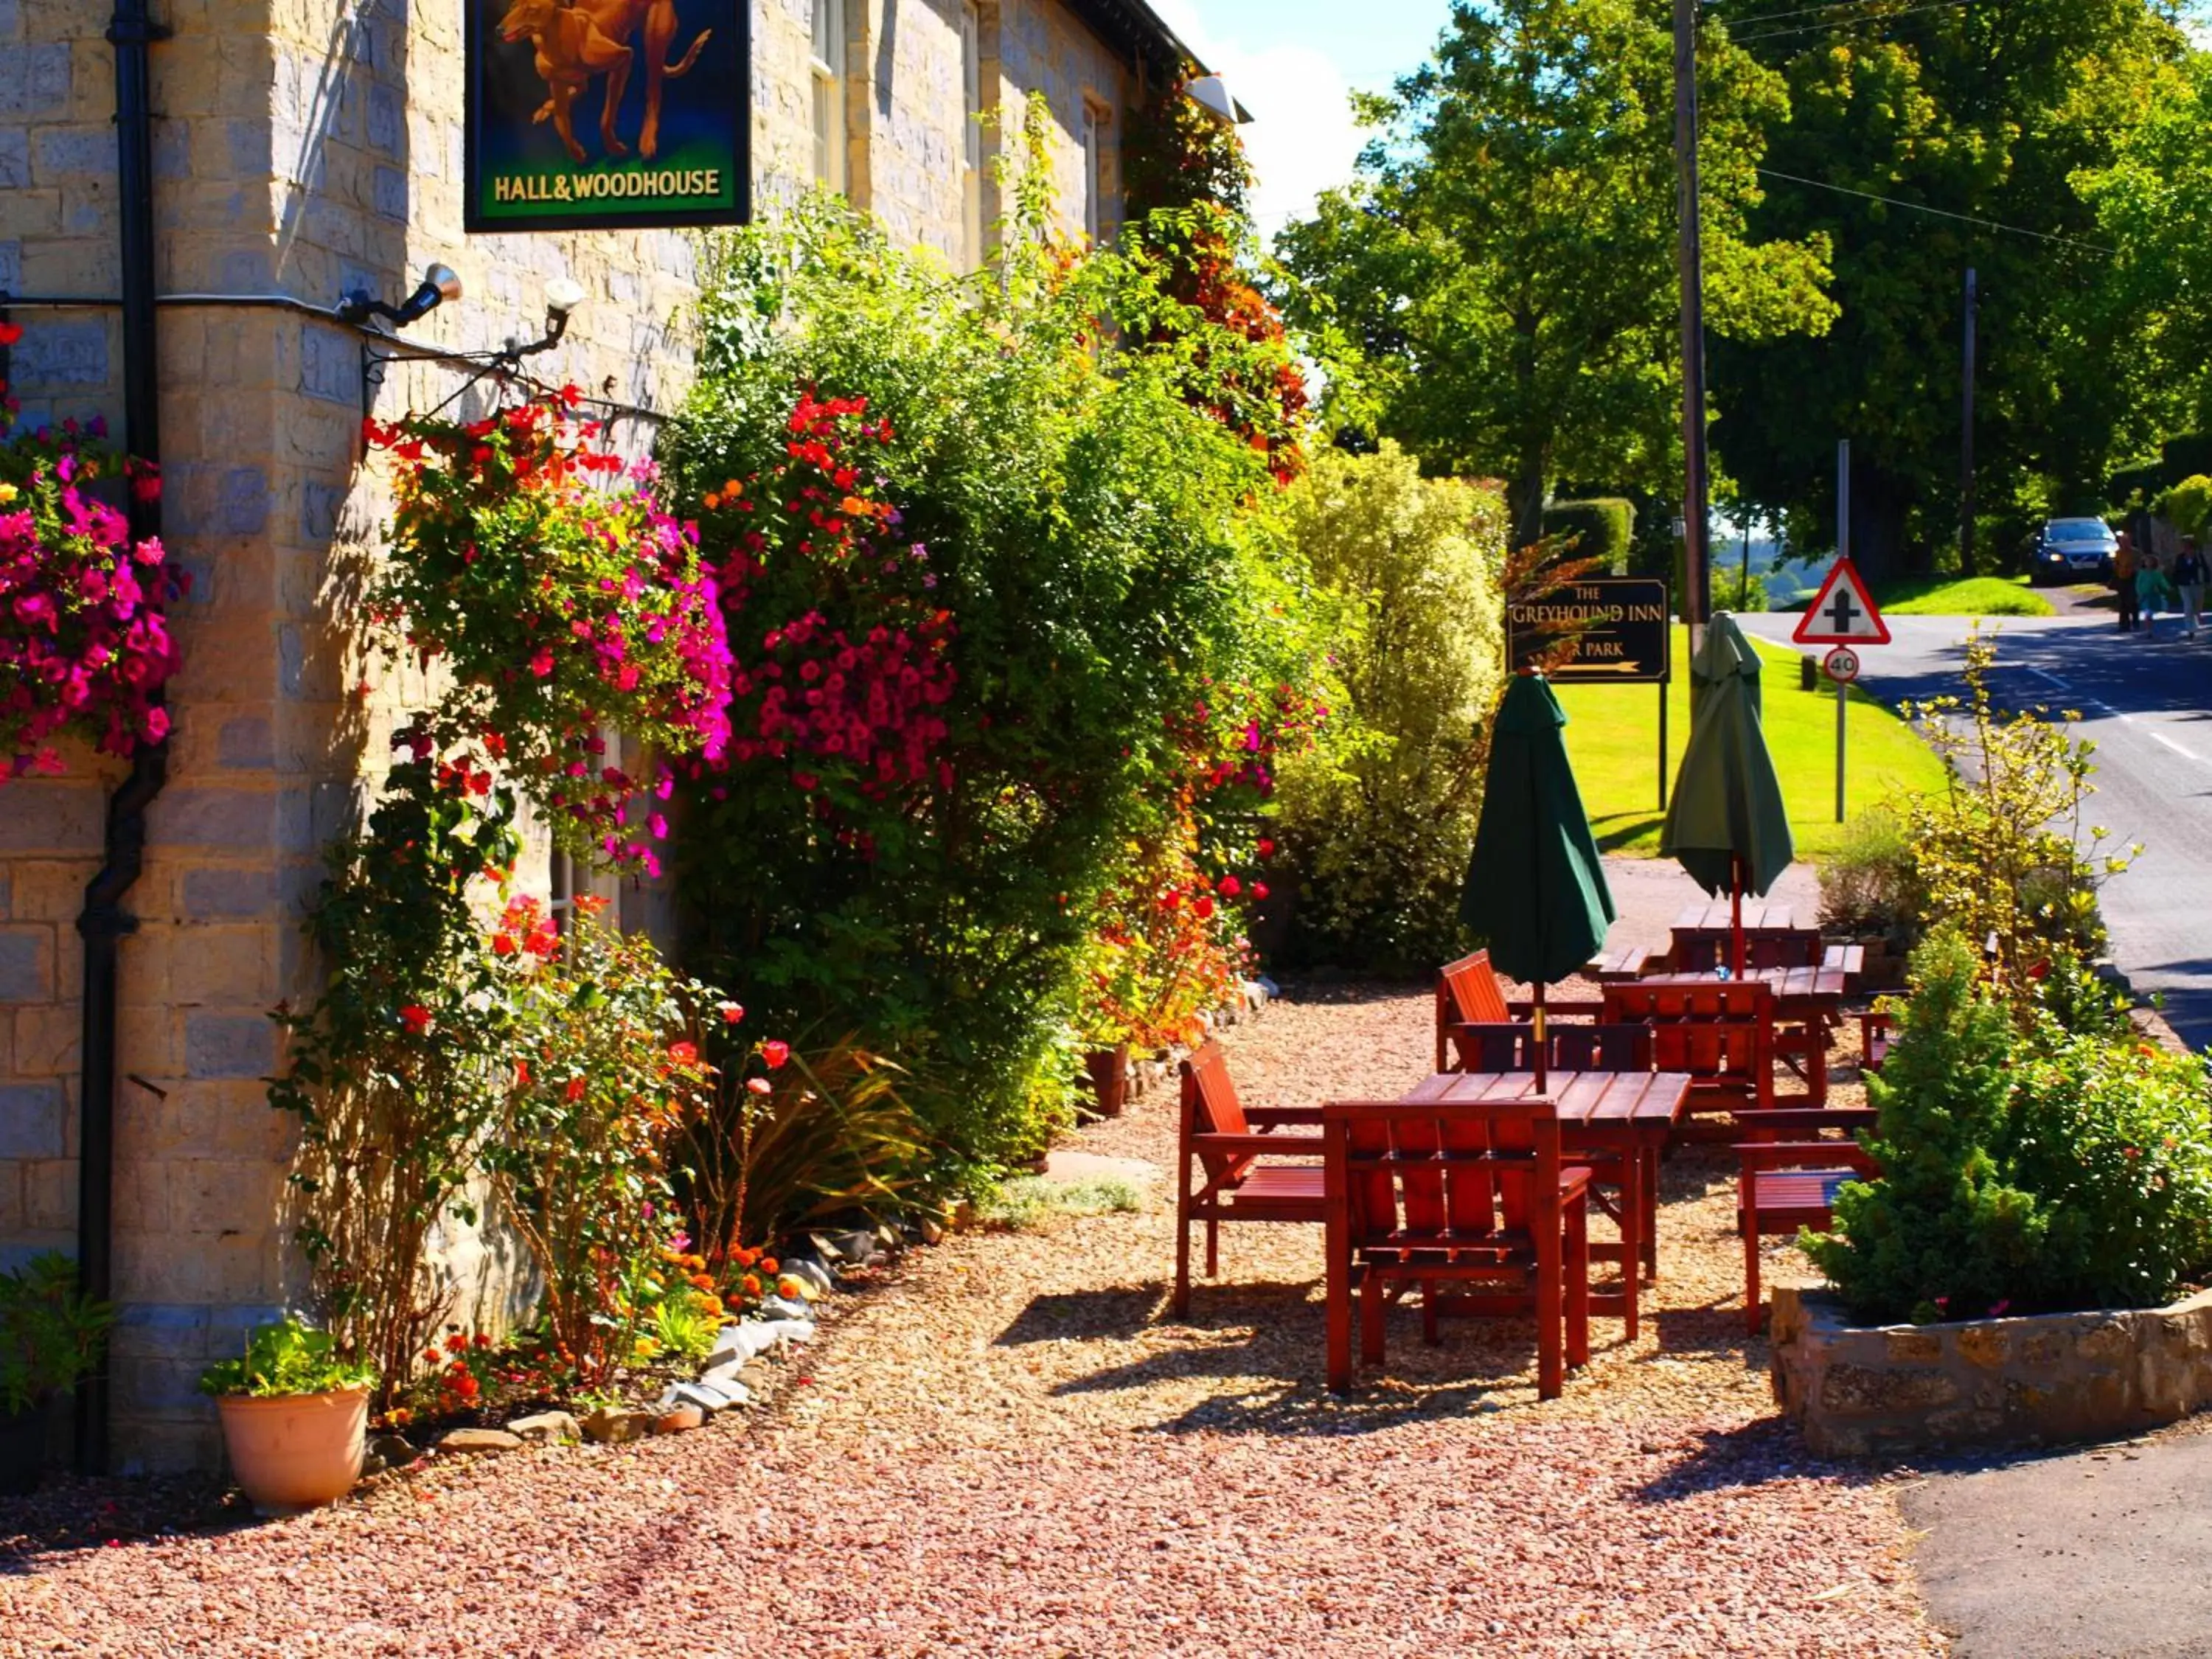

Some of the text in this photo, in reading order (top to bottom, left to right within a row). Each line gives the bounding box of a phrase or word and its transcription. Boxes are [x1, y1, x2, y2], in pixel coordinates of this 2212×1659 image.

[1575, 586, 1599, 599] THE
[1628, 605, 1662, 621] INN
[1586, 642, 1624, 656] PARK
[1830, 657, 1854, 672] 40
